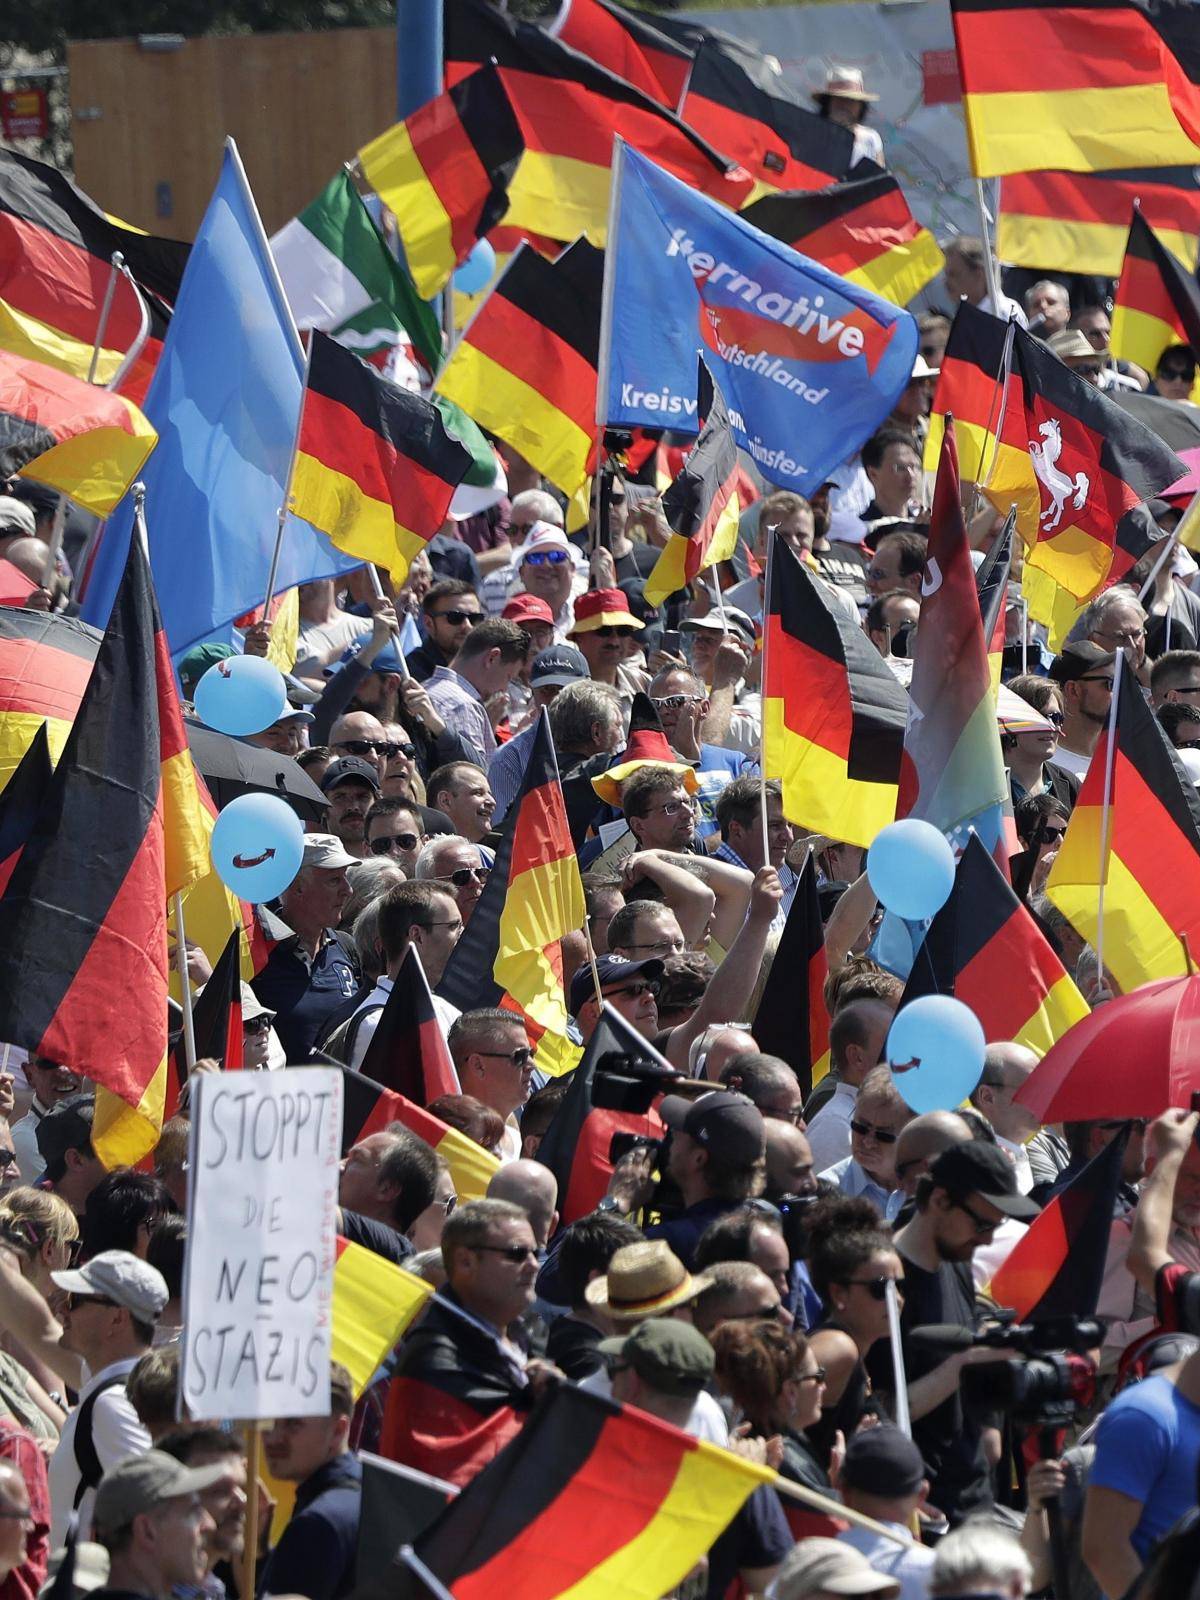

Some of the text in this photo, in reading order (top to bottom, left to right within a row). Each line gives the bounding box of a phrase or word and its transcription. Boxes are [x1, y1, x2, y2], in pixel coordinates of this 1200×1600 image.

[665, 228, 865, 357] lternative
[718, 342, 830, 405] utschland
[748, 436, 808, 477] ünster
[205, 1089, 331, 1170] STOPPT
[242, 1194, 283, 1233] DIE
[215, 1250, 319, 1306] NEO
[188, 1326, 326, 1398] STAZIS
